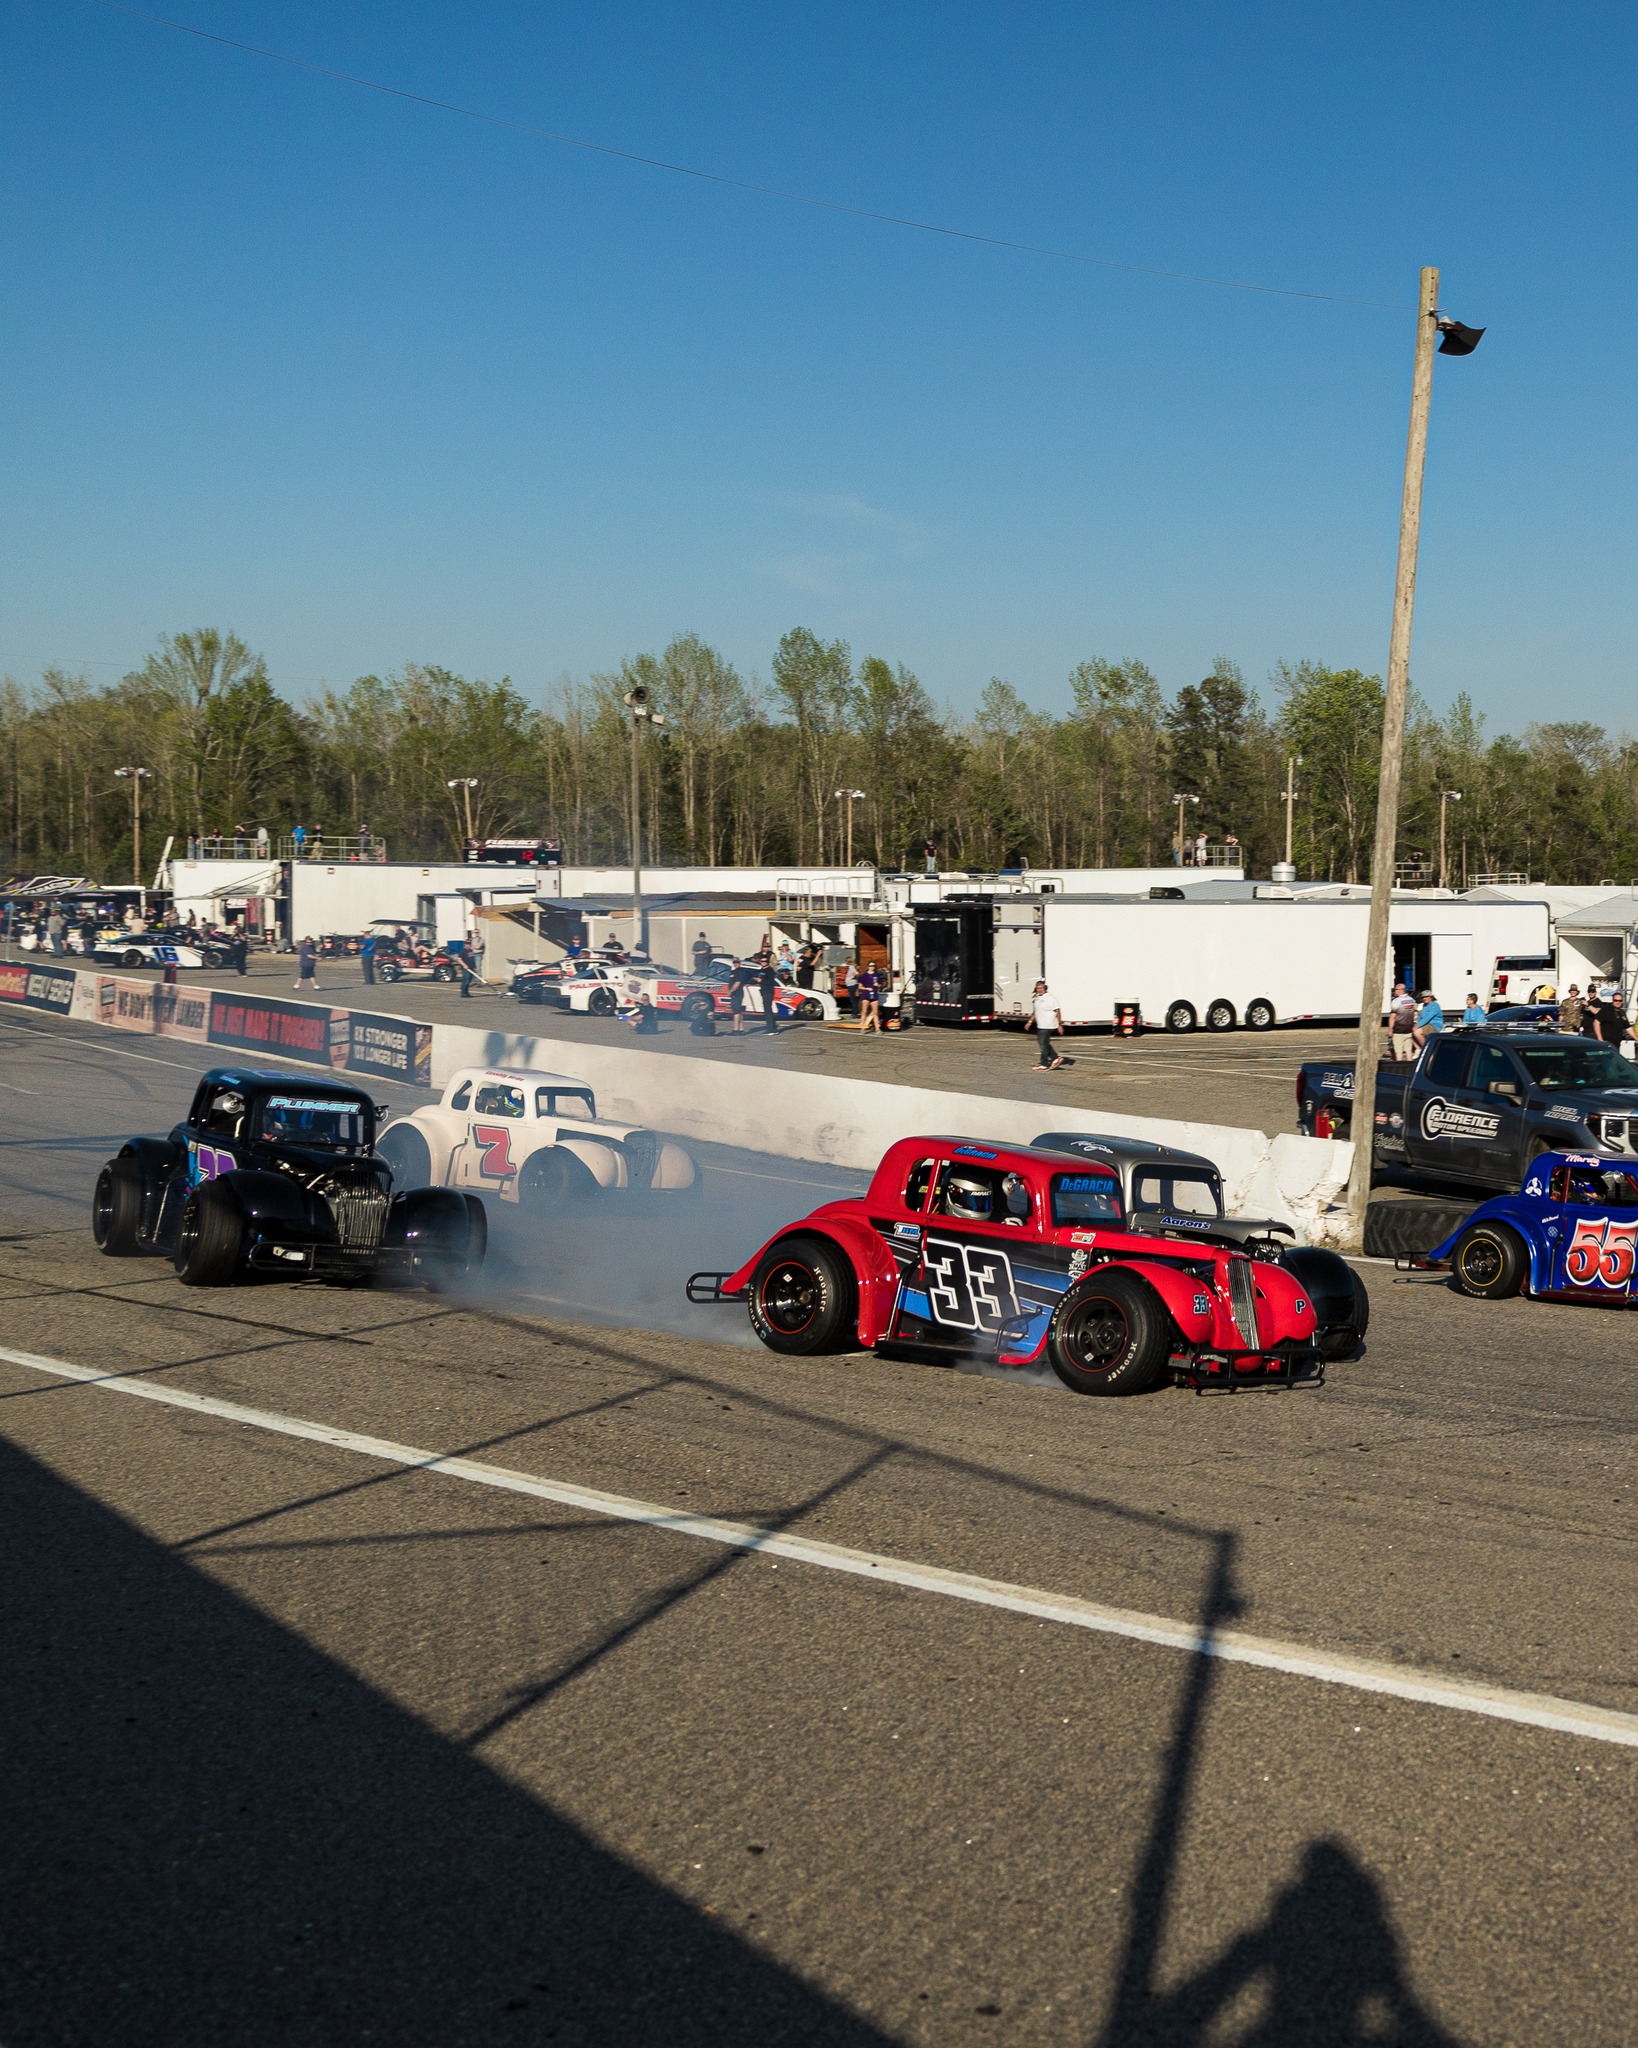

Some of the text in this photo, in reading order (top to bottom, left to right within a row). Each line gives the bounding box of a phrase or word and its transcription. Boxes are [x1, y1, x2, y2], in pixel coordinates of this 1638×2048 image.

[365, 1027, 408, 1051] STRONGER
[365, 1047, 391, 1066] LONGER
[391, 1051, 407, 1070] LIFE
[269, 1097, 361, 1114] PLUMMER
[1431, 1109, 1500, 1129] FLORENCE
[1457, 1125, 1497, 1137] SPEEDWAY
[472, 1124, 517, 1180] 7
[1160, 1215, 1211, 1231] Aaron's
[1566, 1216, 1638, 1288] 55
[922, 1238, 1027, 1337] 33
[1193, 1294, 1209, 1315] 33
[1295, 1299, 1306, 1314] P
[1106, 1341, 1138, 1382] Hoosier
